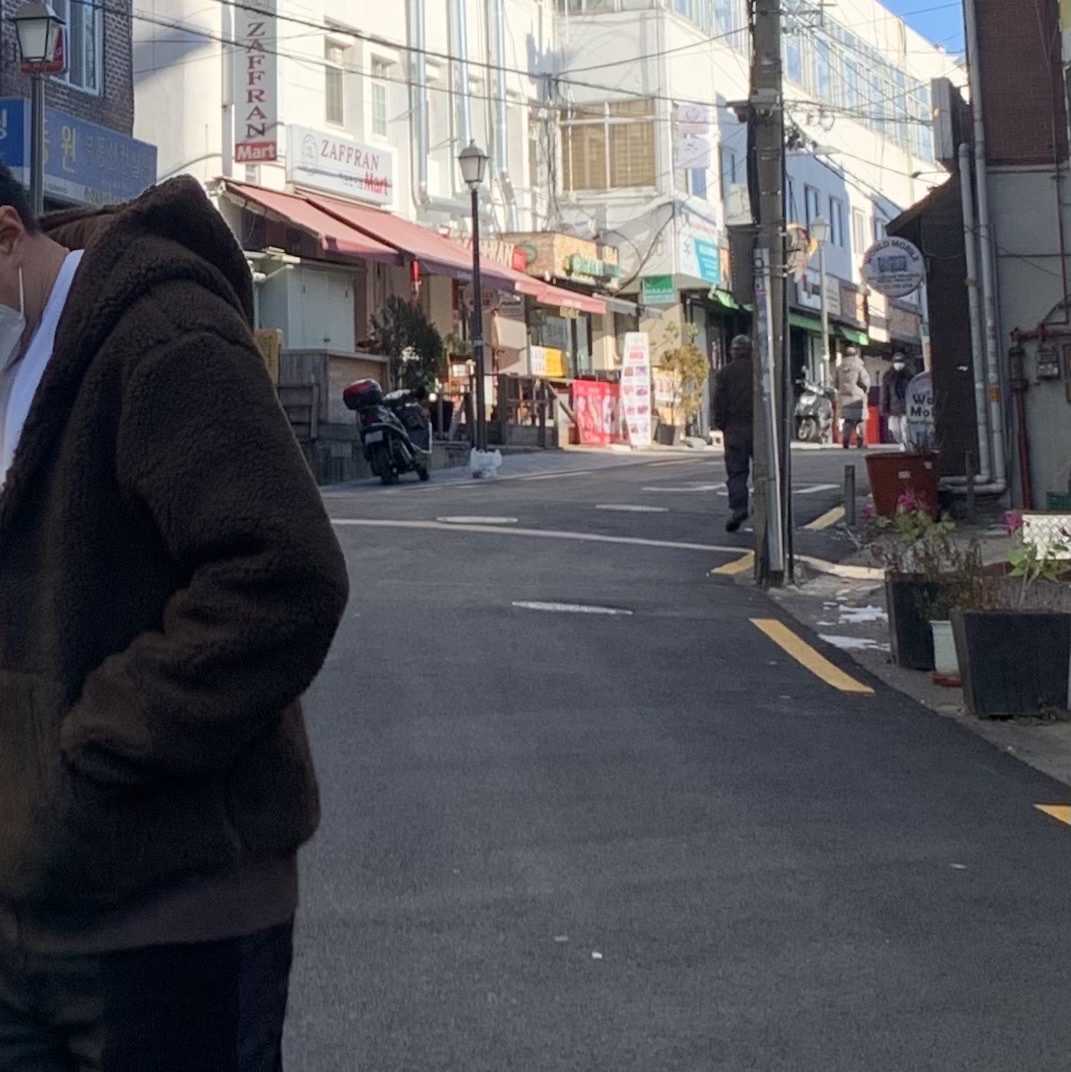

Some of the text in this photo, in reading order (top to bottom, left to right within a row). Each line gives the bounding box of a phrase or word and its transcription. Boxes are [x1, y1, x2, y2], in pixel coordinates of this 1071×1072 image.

[246, 22, 268, 139] ZAFFRAN
[237, 145, 275, 160] Mart
[320, 140, 380, 171] ZAFFRAN
[364, 170, 390, 197] Mart
